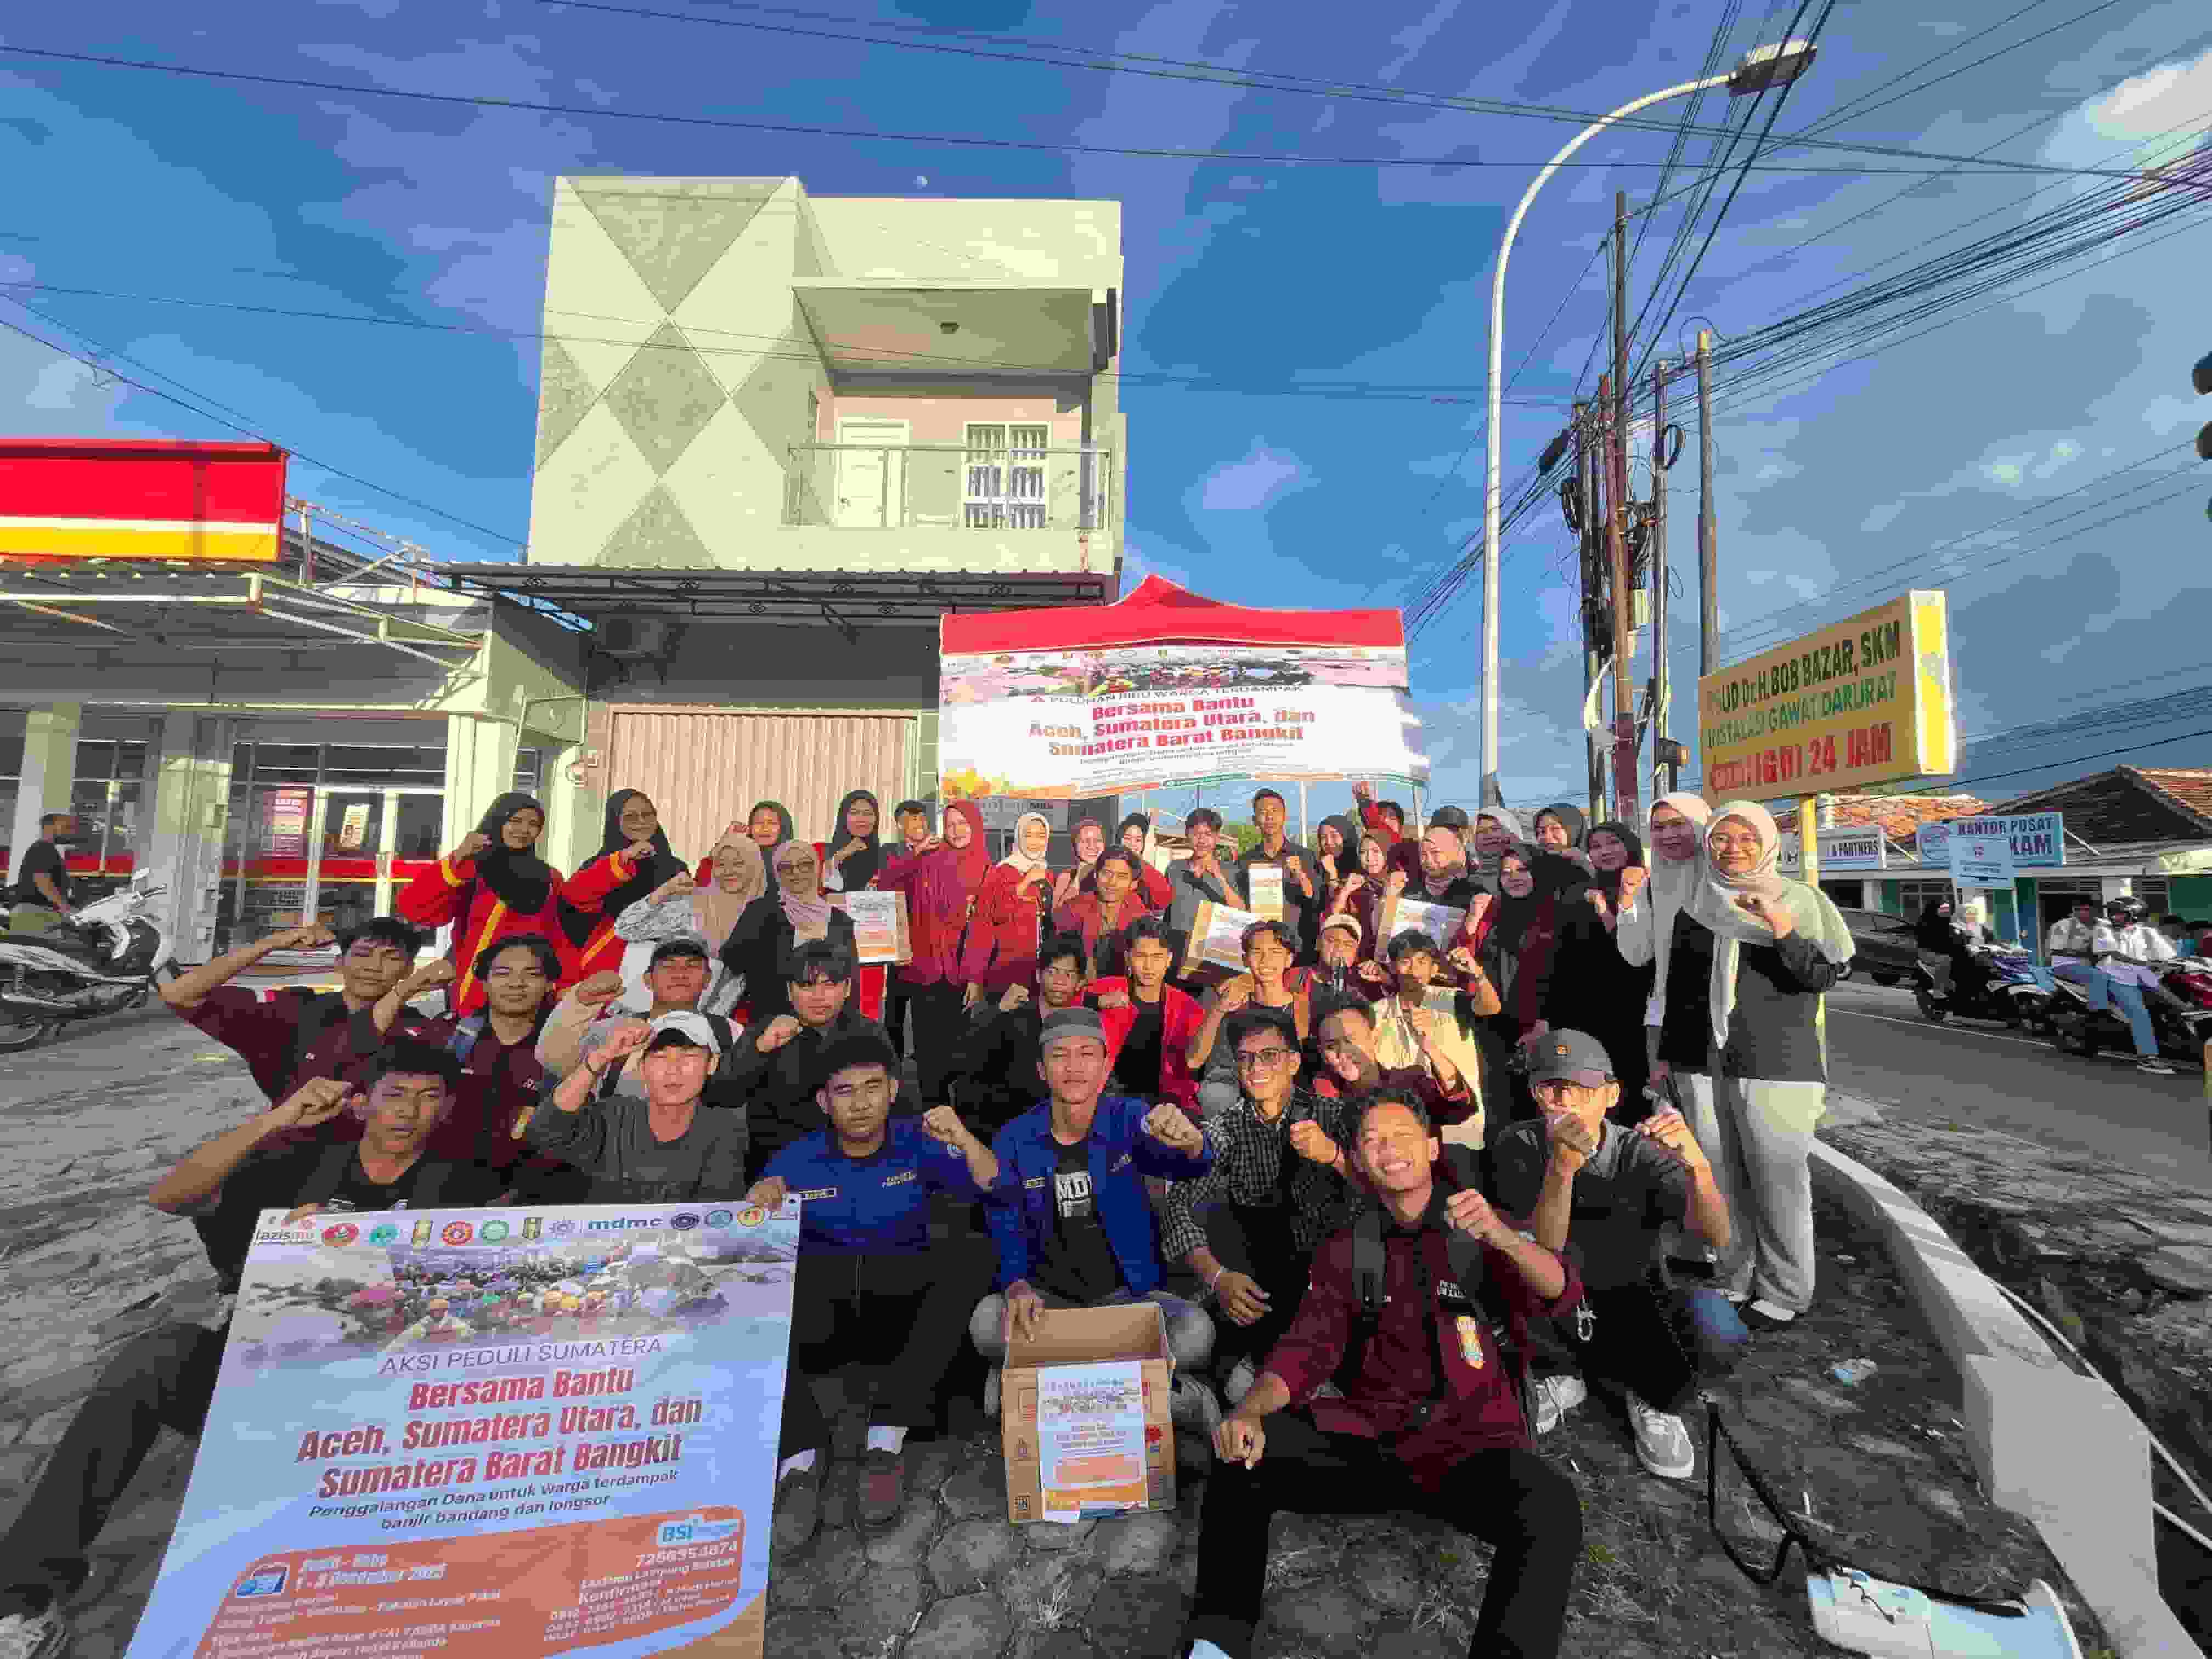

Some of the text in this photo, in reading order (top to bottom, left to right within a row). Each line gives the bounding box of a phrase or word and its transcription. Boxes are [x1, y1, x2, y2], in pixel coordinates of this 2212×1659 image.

[1771, 658, 1799, 698] BOB
[1802, 639, 1859, 688] BAZAR,
[1861, 619, 1901, 668] SKM
[1092, 696, 1254, 720] Bersama Bantu
[1094, 718, 1197, 737] Sumatera
[1156, 730, 1212, 747] Barat
[380, 1338, 663, 1374] AKSI PEDULI SUMATERA
[408, 1368, 633, 1412] Bersama Bantu
[294, 1396, 703, 1463] Aceh, Sumatera Utara, dan
[319, 1434, 683, 1498] Sumatera Barat Bangkit
[308, 1496, 438, 1517] Penggalangan
[442, 1491, 485, 1506] Dana
[488, 1483, 537, 1502] untuk
[594, 1470, 679, 1490] terdampak
[436, 1505, 510, 1525] bandang
[515, 1500, 545, 1516] dan
[549, 1494, 611, 1513] longsor
[662, 1524, 694, 1542] BSI
